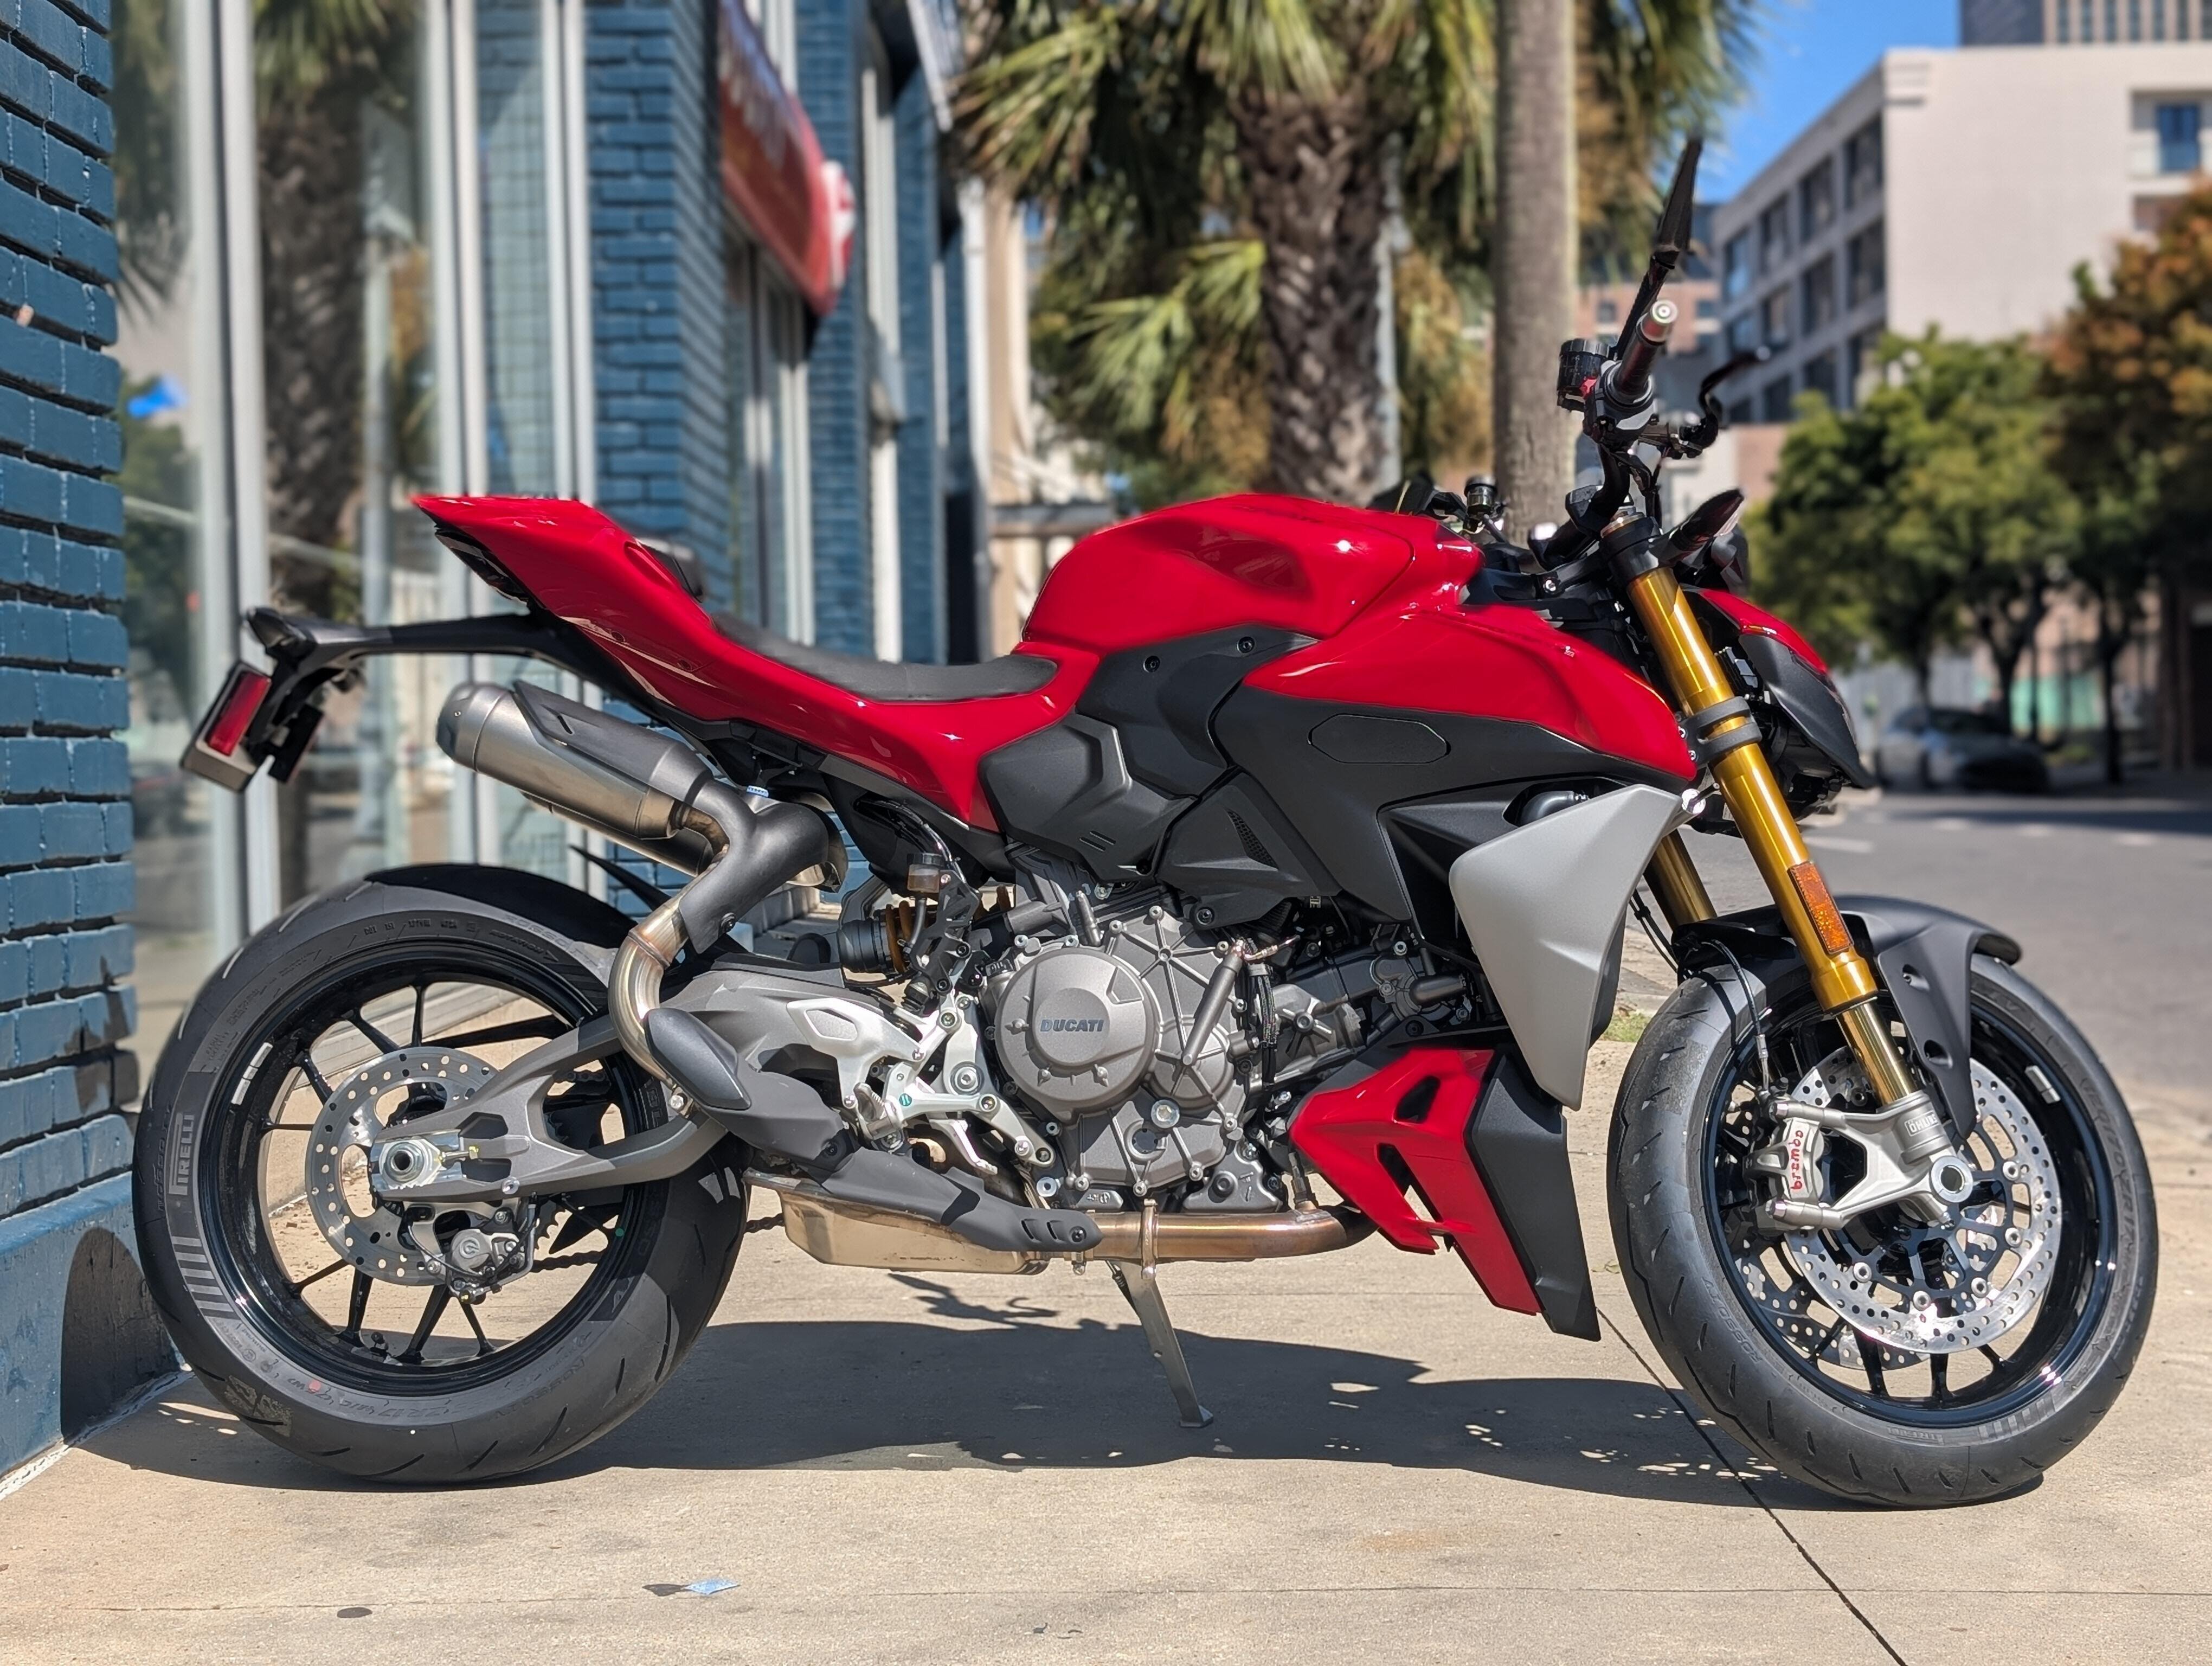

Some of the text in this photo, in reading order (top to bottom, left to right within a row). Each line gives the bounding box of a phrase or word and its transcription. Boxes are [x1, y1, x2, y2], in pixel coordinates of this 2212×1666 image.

[1040, 1019, 1104, 1032] DUCATI
[169, 1113, 195, 1195] PIRELLI
[1789, 1130, 1804, 1190] brembo
[1719, 1306, 1763, 1363] ROSSO
